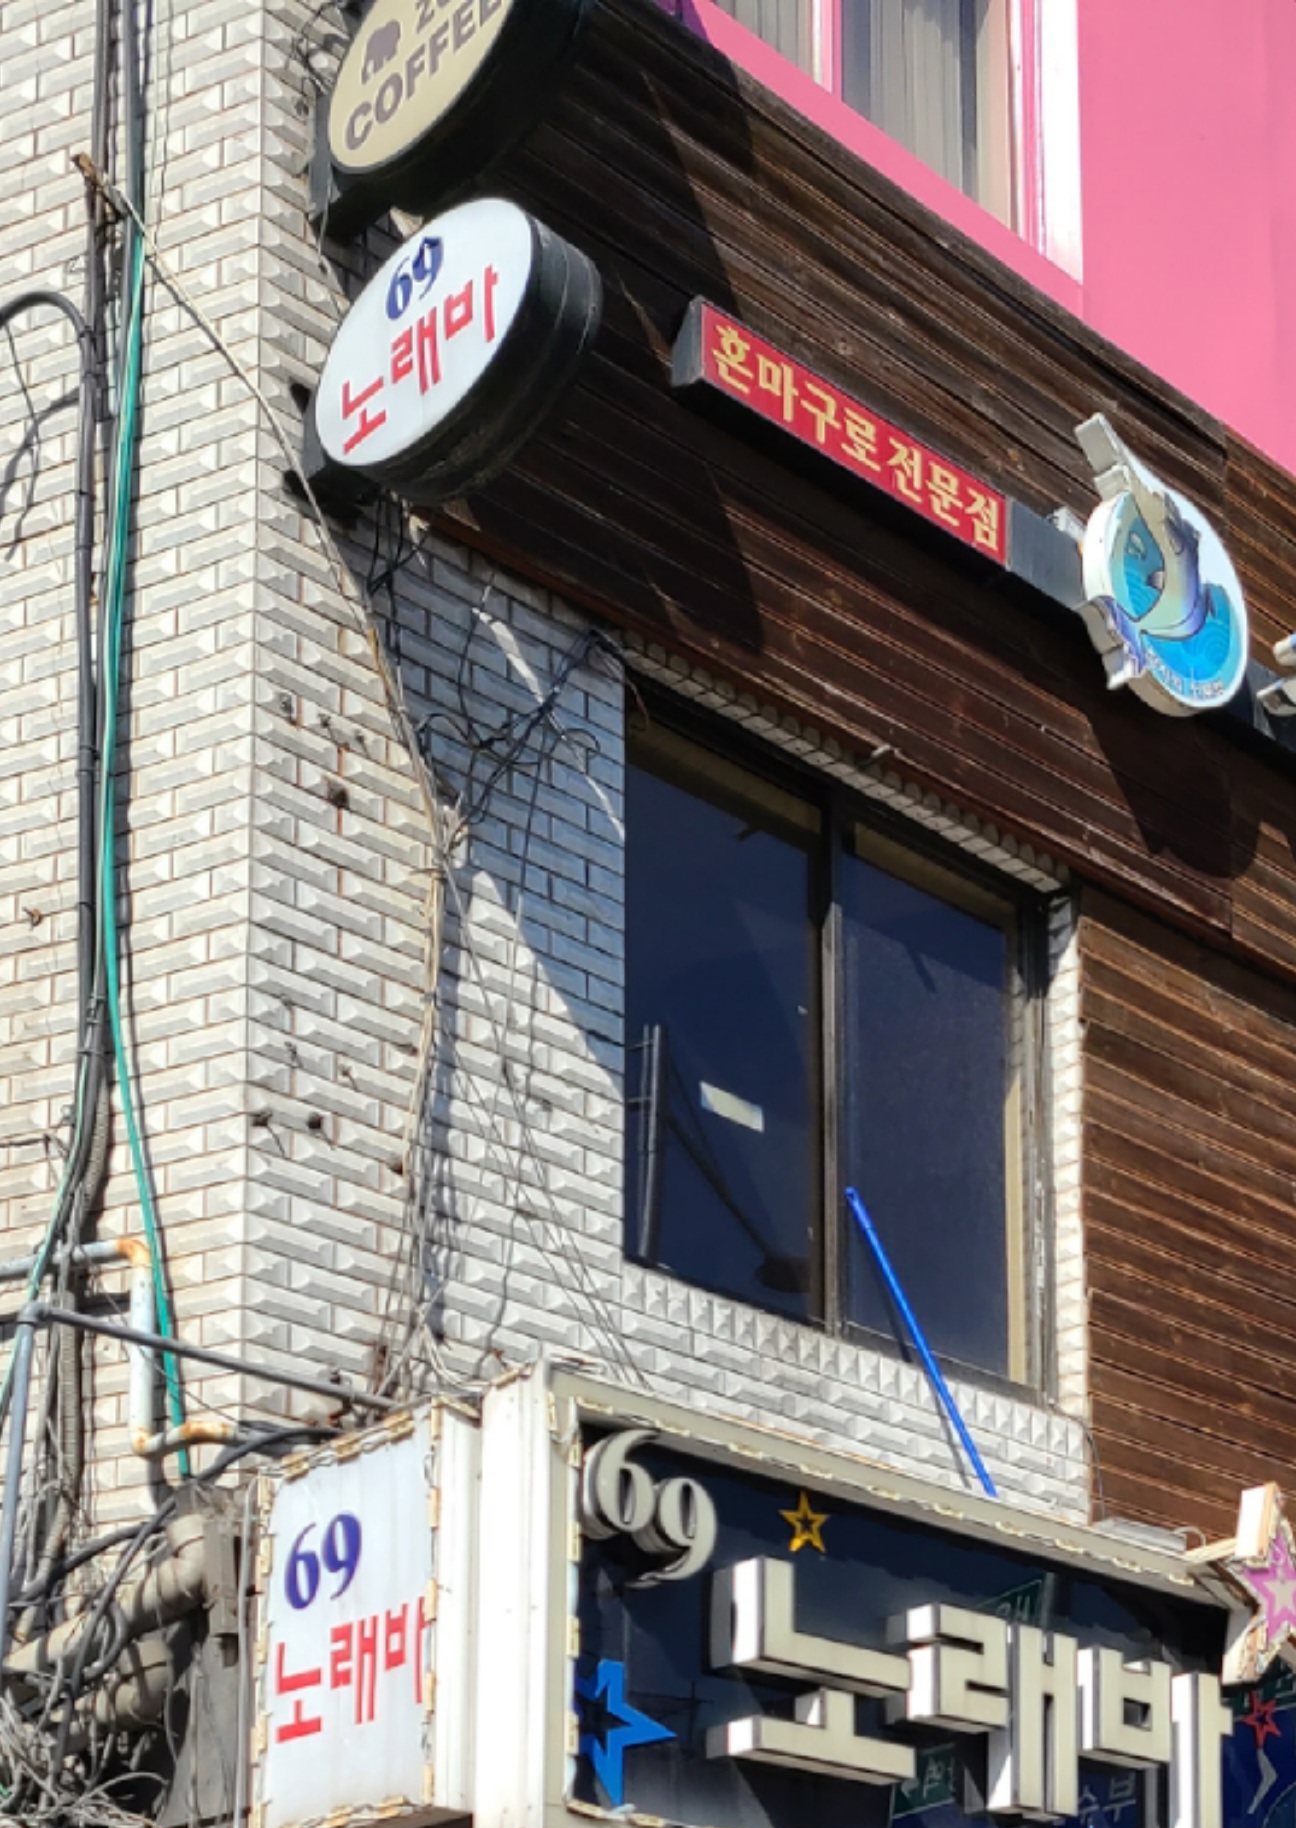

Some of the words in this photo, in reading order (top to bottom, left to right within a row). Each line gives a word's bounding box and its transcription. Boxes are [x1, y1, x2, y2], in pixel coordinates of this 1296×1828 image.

[386, 236, 444, 321] 69
[341, 263, 499, 456] 노래바
[711, 324, 1000, 551] 혼마구로전문점
[283, 1512, 362, 1611] 69
[583, 1428, 717, 1589] 69
[275, 1596, 430, 1744] 노래바
